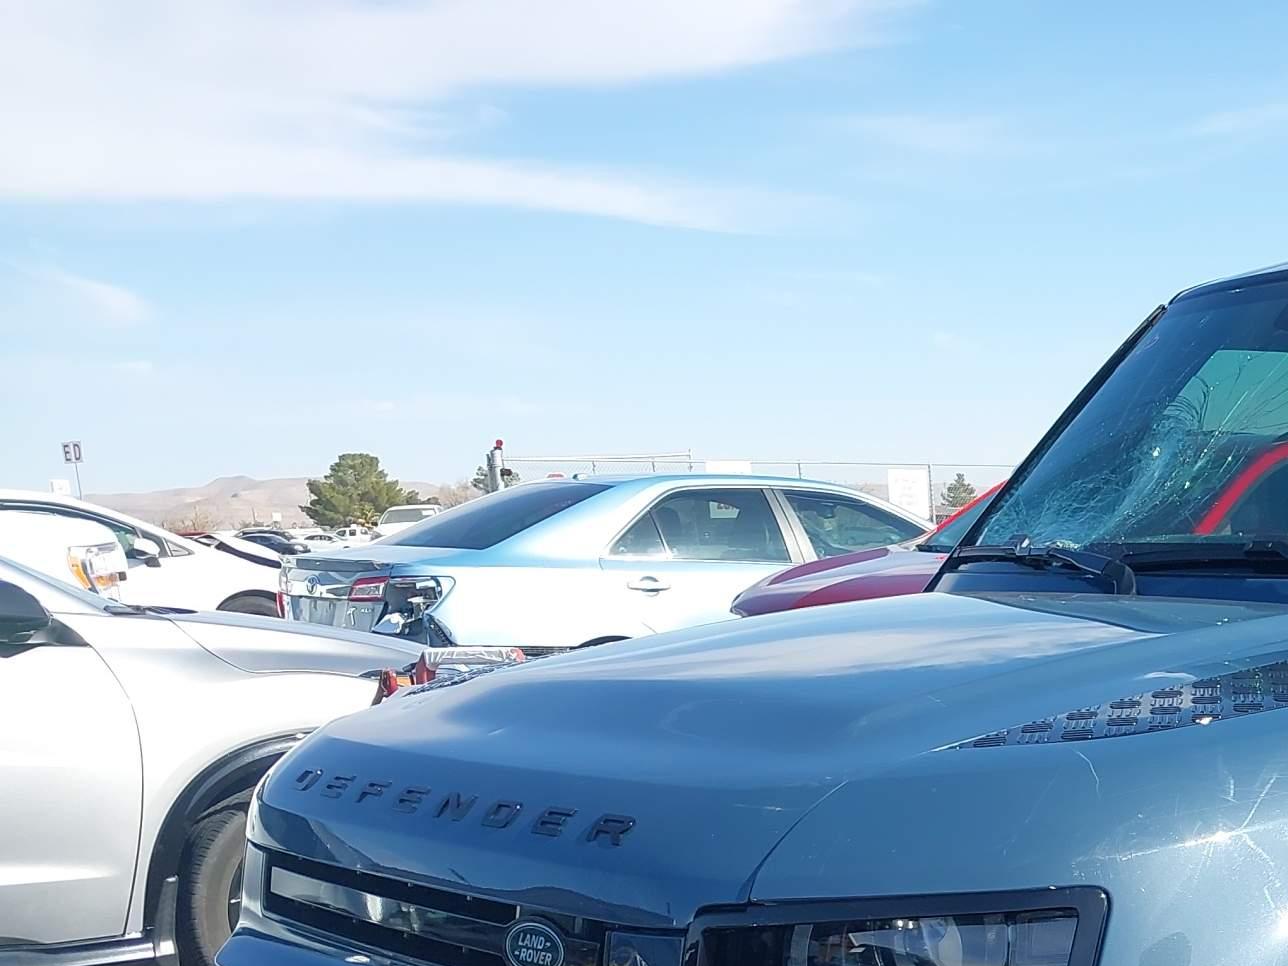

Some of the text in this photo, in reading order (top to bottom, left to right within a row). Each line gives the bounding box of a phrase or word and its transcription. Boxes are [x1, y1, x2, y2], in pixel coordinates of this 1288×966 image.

[293, 768, 637, 847] DEFENDER
[518, 932, 546, 949] LAND
[519, 948, 553, 966] ROVER
